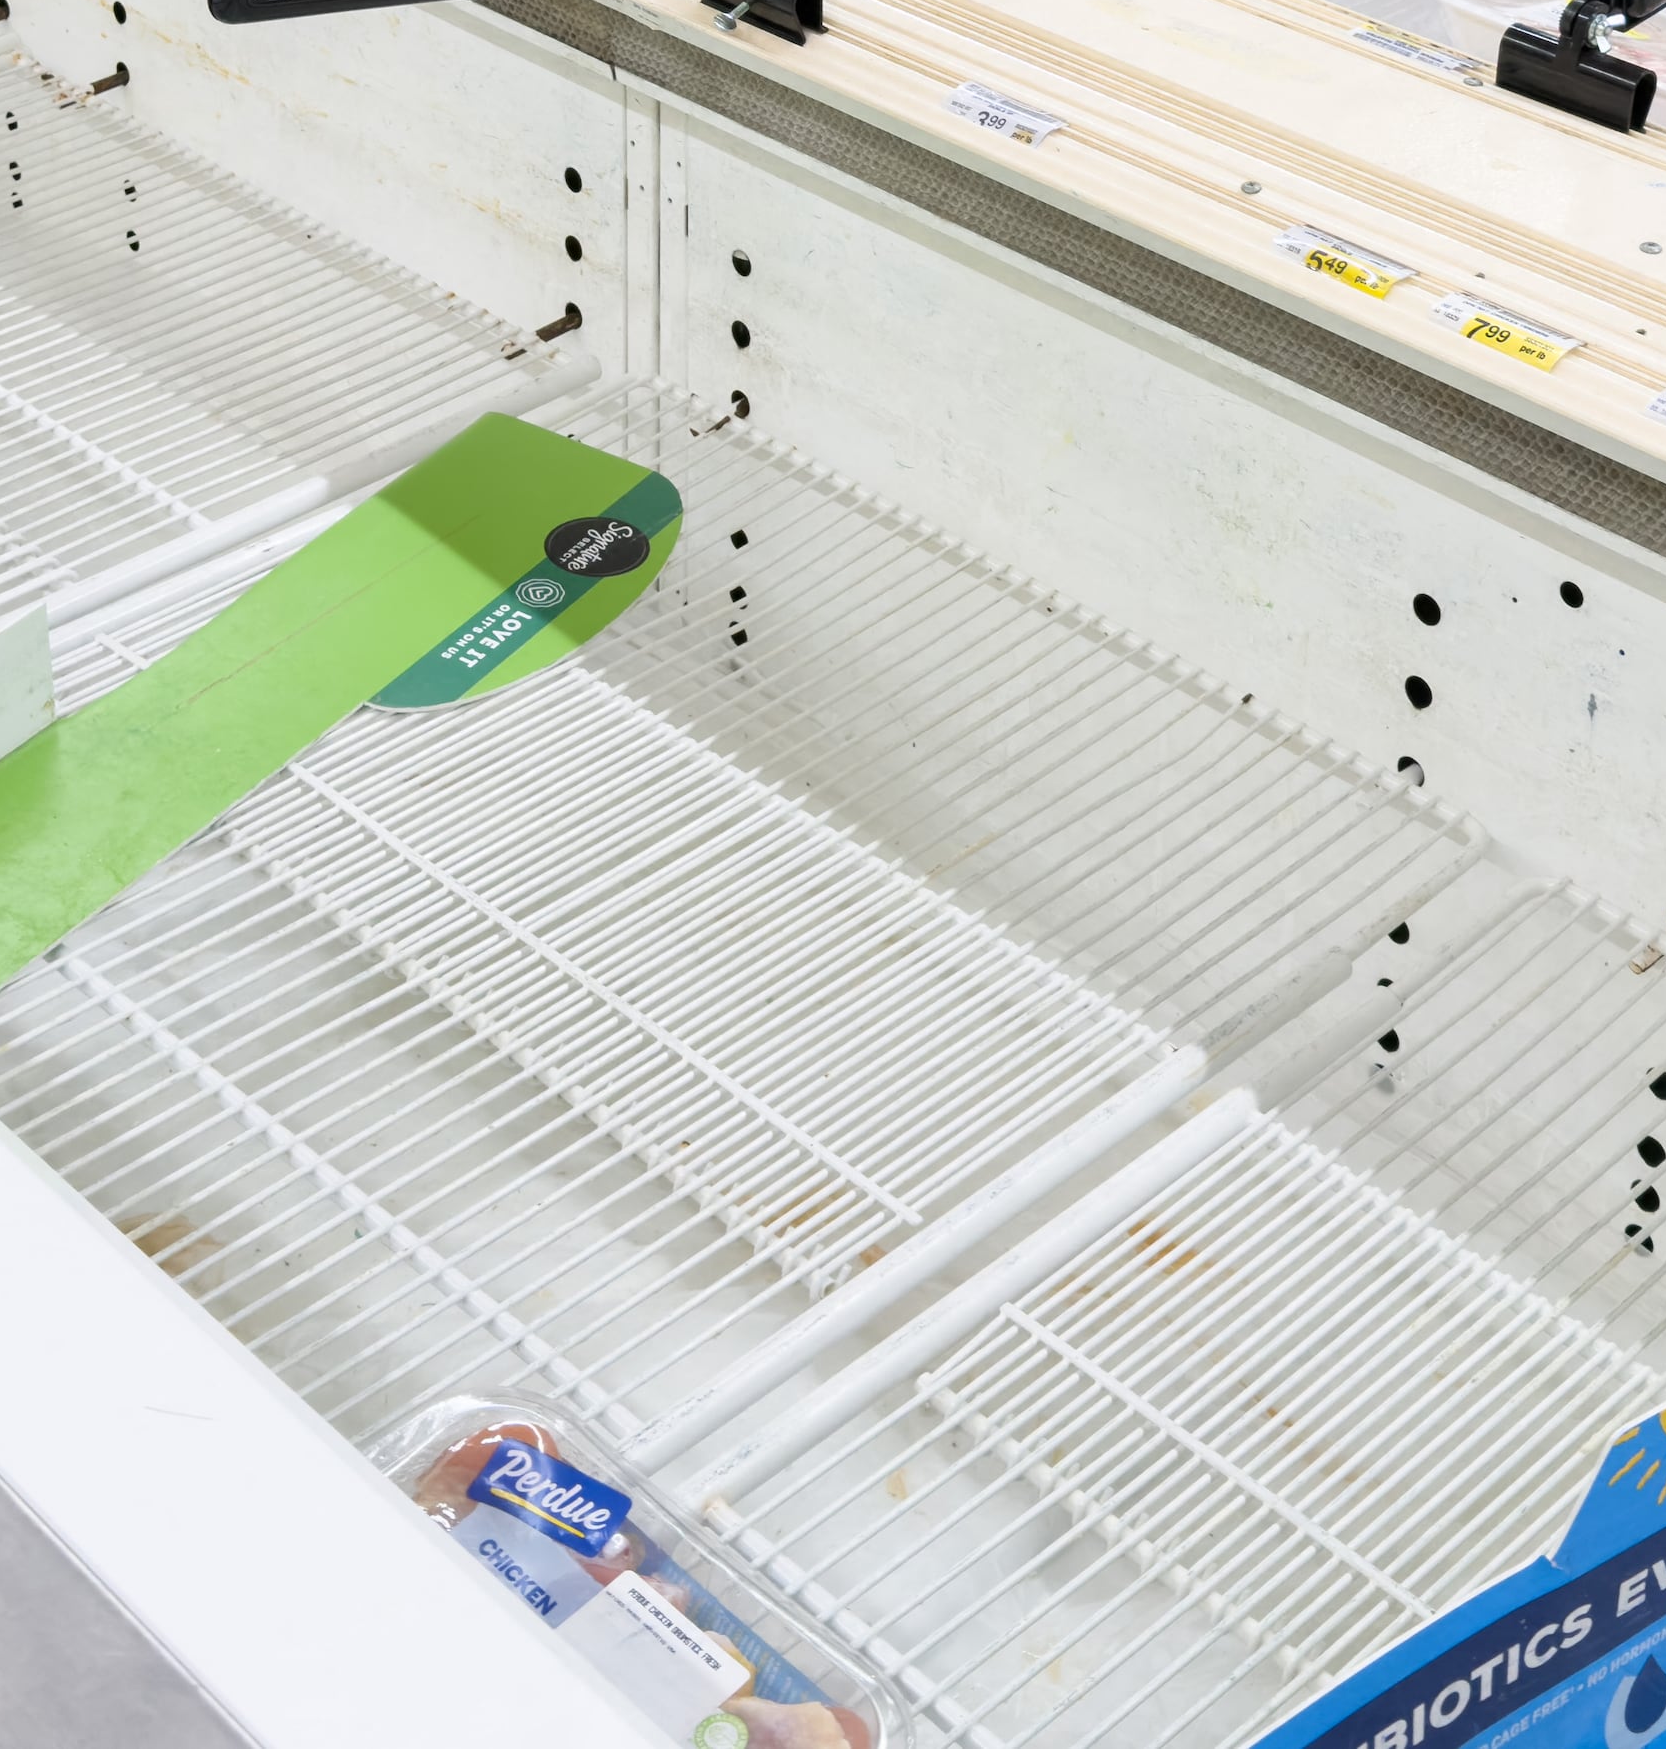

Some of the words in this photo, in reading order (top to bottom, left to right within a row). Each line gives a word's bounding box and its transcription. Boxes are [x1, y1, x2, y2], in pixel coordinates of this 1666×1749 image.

[1518, 344, 1536, 356] per
[1536, 350, 1546, 361] lb
[567, 521, 634, 572] Signature
[489, 1448, 611, 1532] Perdue
[478, 1538, 558, 1617] CHICKEN
[648, 1605, 675, 1629] CHICKEN
[670, 1624, 703, 1655] DRUMSTICK
[700, 1652, 722, 1672] FRESH
[1586, 1665, 1608, 1689] NO
